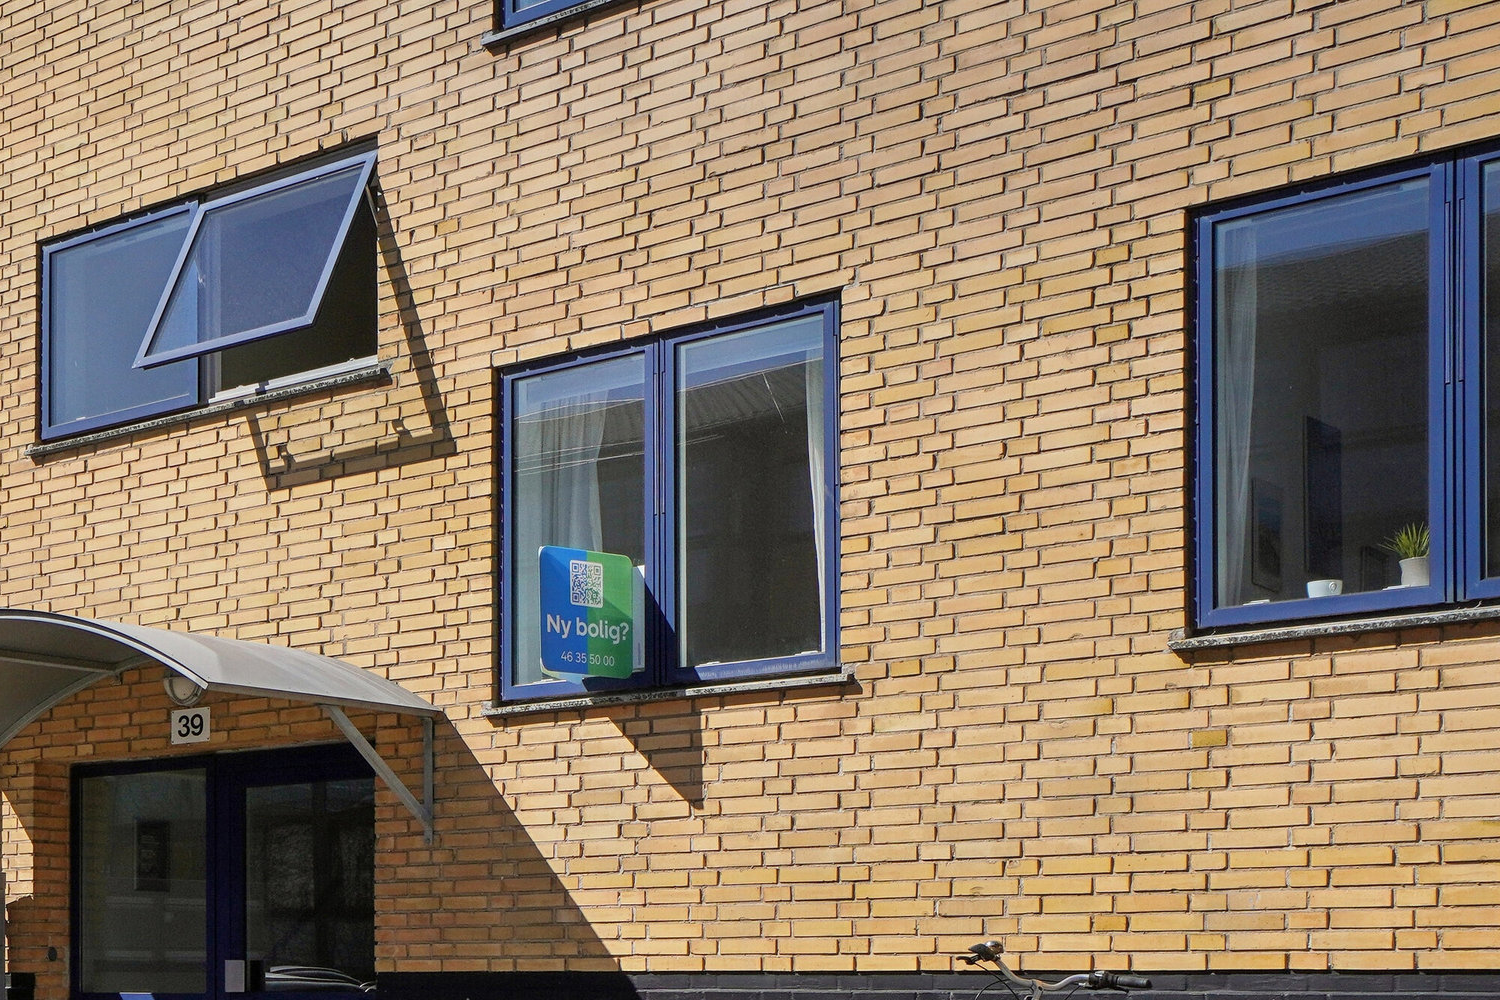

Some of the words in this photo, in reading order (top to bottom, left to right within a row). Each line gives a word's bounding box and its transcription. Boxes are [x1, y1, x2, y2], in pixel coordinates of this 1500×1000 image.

[546, 613, 572, 639] Ny
[575, 616, 630, 645] bolig?
[560, 650, 574, 663] 46
[575, 652, 588, 664] 35
[589, 653, 601, 665] 50
[602, 655, 616, 667] 00
[177, 713, 204, 738] 39
